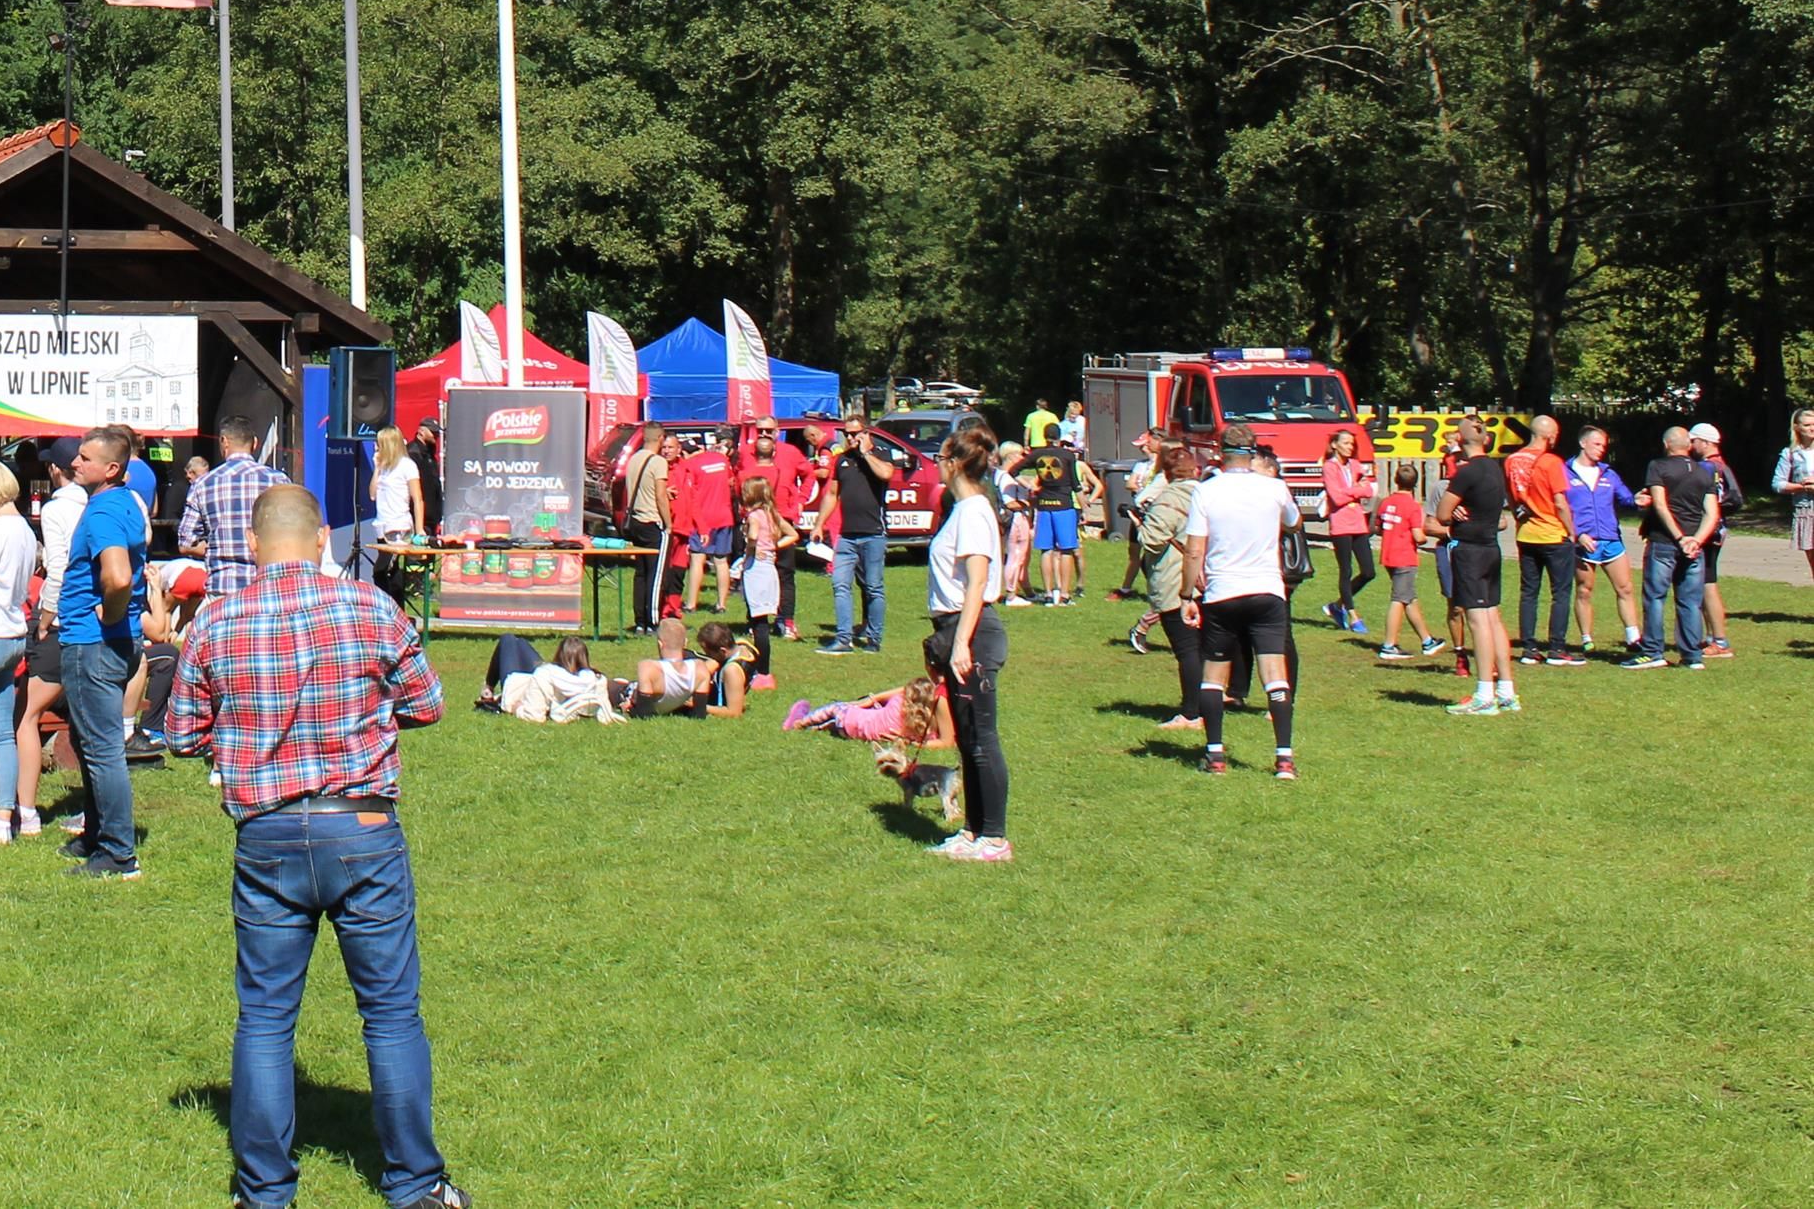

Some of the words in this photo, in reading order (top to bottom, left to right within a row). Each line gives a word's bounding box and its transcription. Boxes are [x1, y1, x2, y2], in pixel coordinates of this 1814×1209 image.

[47, 330, 120, 356] MIEJSKI
[7, 370, 25, 395] W
[30, 370, 90, 395] LIPNIE
[489, 409, 542, 432] Polskie
[463, 459, 483, 477] SĄ
[485, 460, 540, 475] POWODY
[485, 476, 503, 490] DO
[506, 476, 565, 491] JEDZENIA
[885, 489, 917, 504] PR
